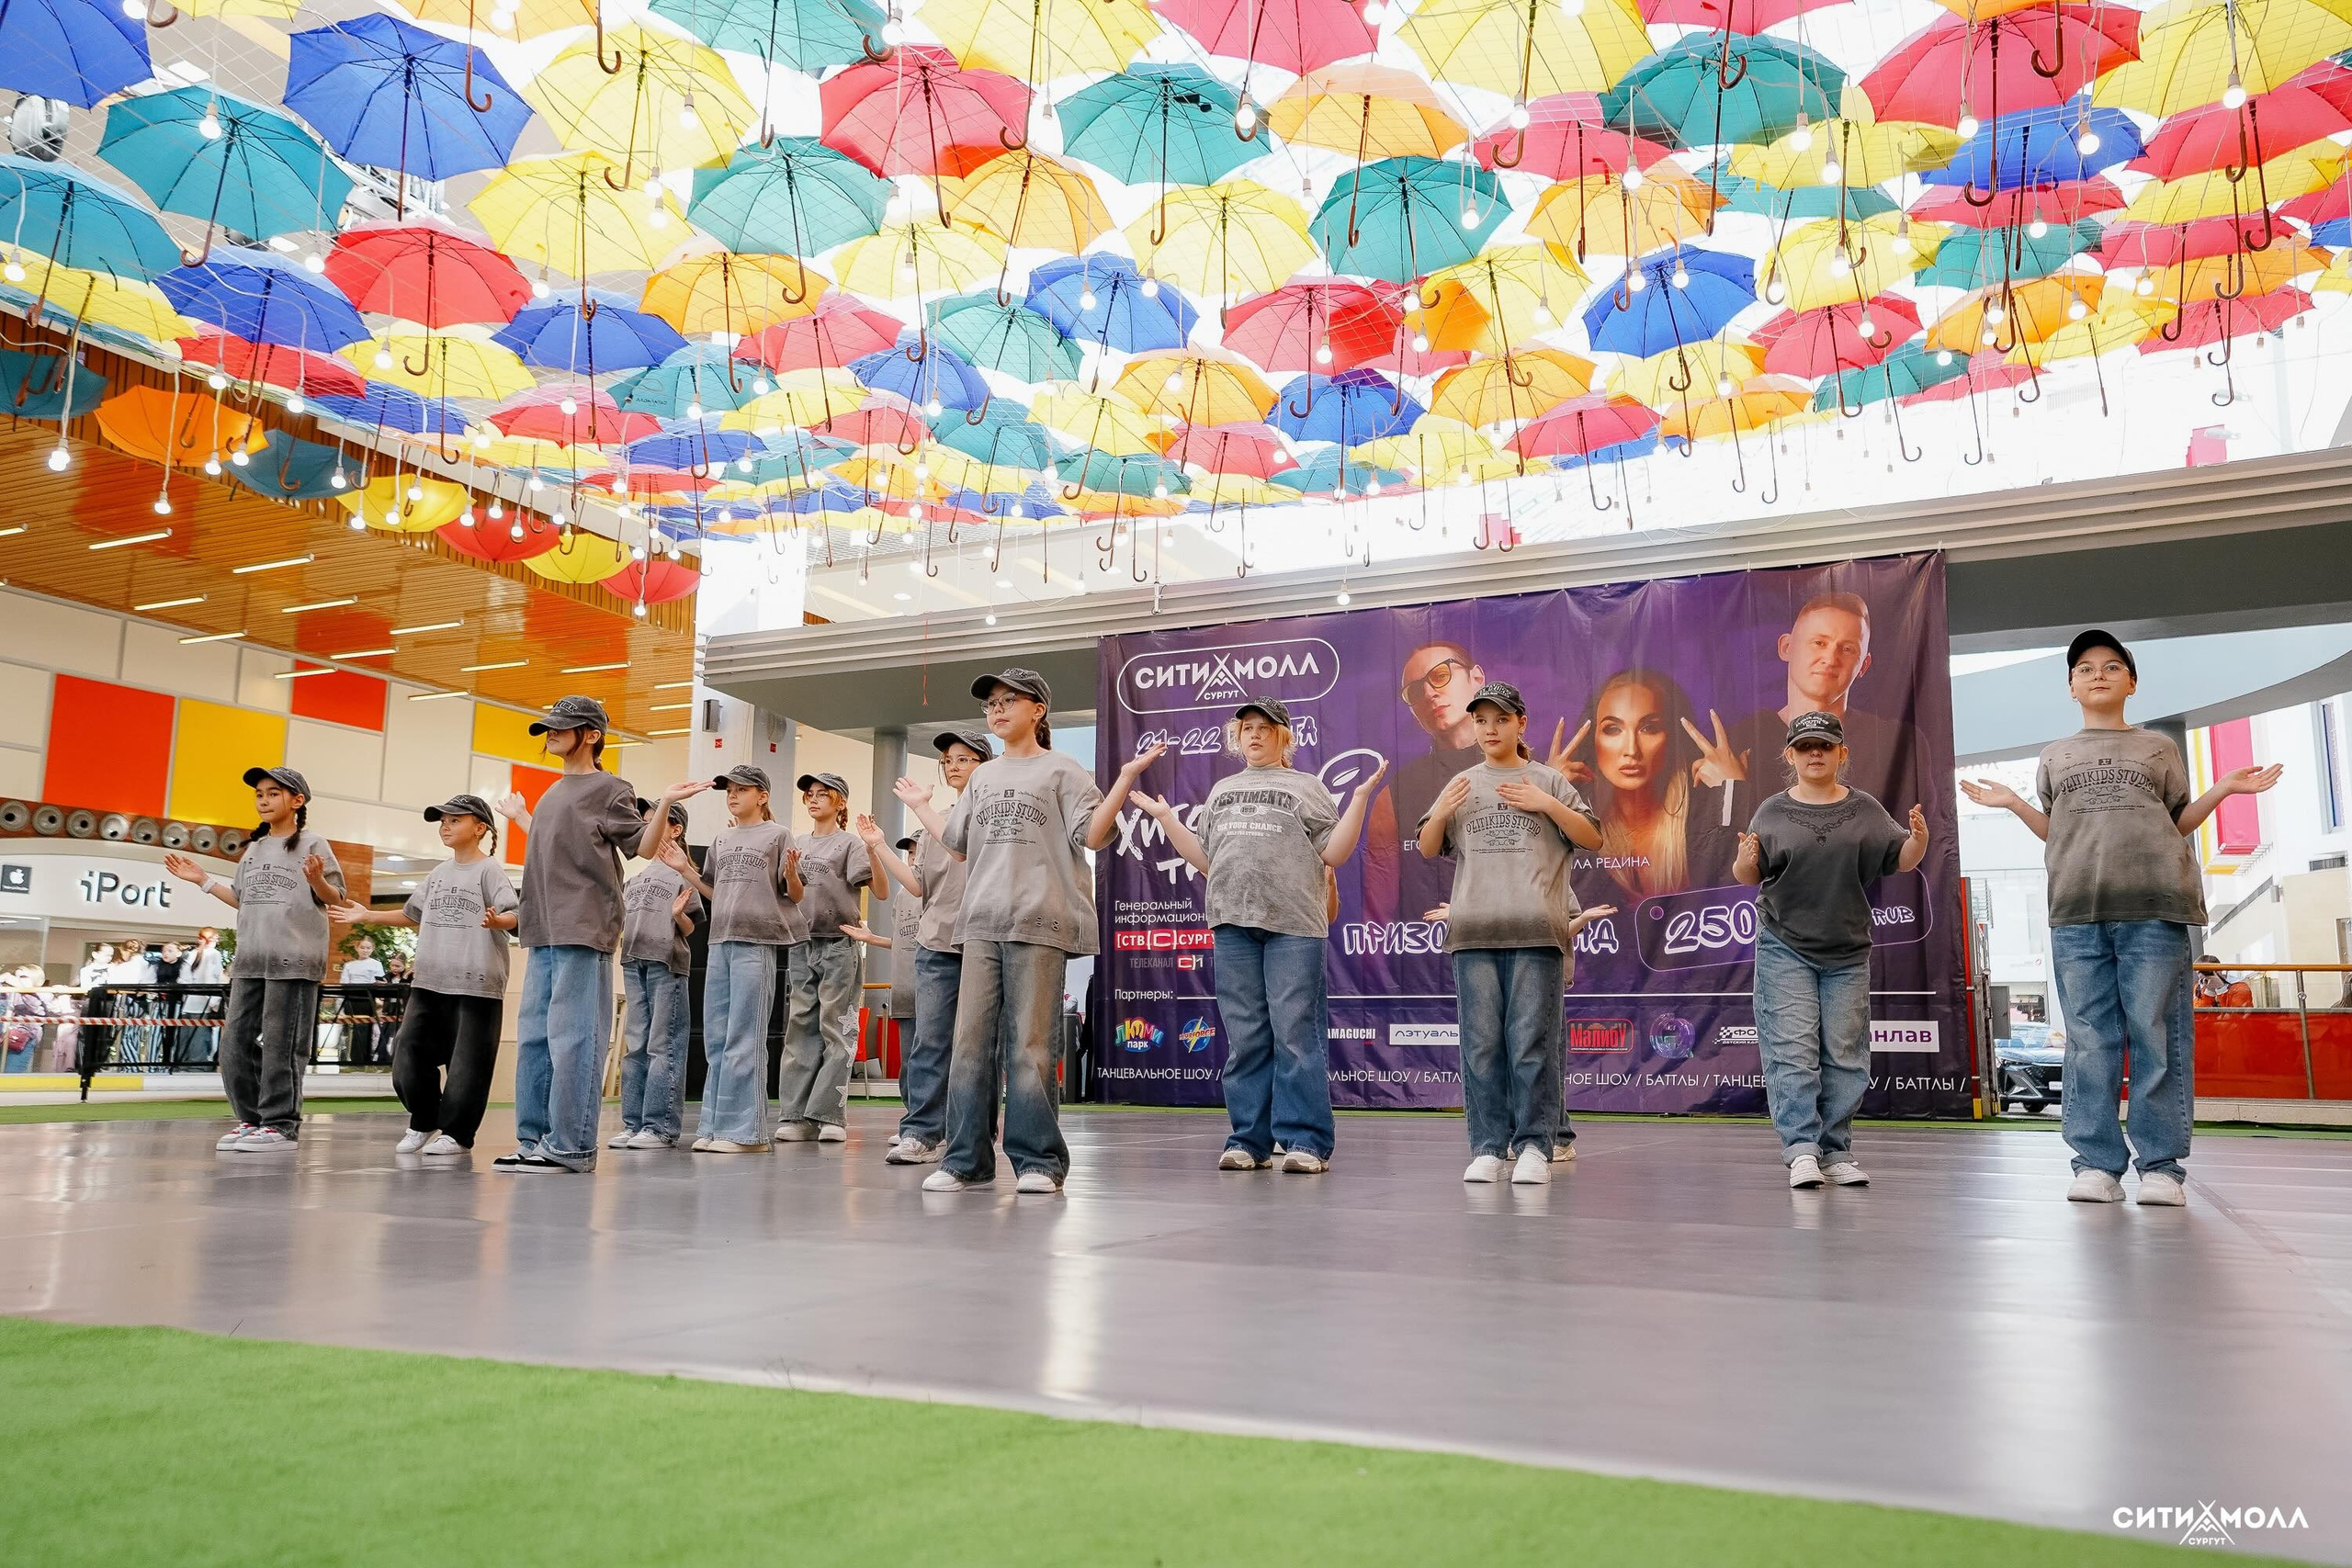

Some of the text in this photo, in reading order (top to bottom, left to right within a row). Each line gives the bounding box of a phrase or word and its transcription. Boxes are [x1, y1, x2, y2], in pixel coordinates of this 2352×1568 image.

[1135, 652, 1320, 689] СИТИ МОЛЛ
[1204, 690, 1239, 701] СУРГУТ
[1016, 802, 1048, 828] STUDIO
[1250, 822, 1283, 833] CHANCE
[1511, 815, 1542, 837] STUDIO
[1570, 855, 1651, 871] ЛА РЕДИНА
[80, 869, 172, 908] iPort
[1114, 897, 1193, 915] Генеральный
[1114, 911, 1208, 926] информацион
[1871, 906, 1915, 927] RUB
[1129, 956, 1174, 969] ТЕЛЕКАНАЛ
[1114, 988, 1174, 1002] Партнеры:
[1126, 1040, 1148, 1051] парк
[1097, 1067, 1182, 1081] ТАНЦЕВАЛЬНОЕ
[1183, 1068, 1213, 1081] ШОУ
[1378, 1070, 1410, 1083] ШОУ
[1596, 1073, 1632, 1086] ШОУ
[1645, 1074, 1699, 1087] БАТТЛЫ
[1895, 1077, 1955, 1090] БАТТЛЫ
